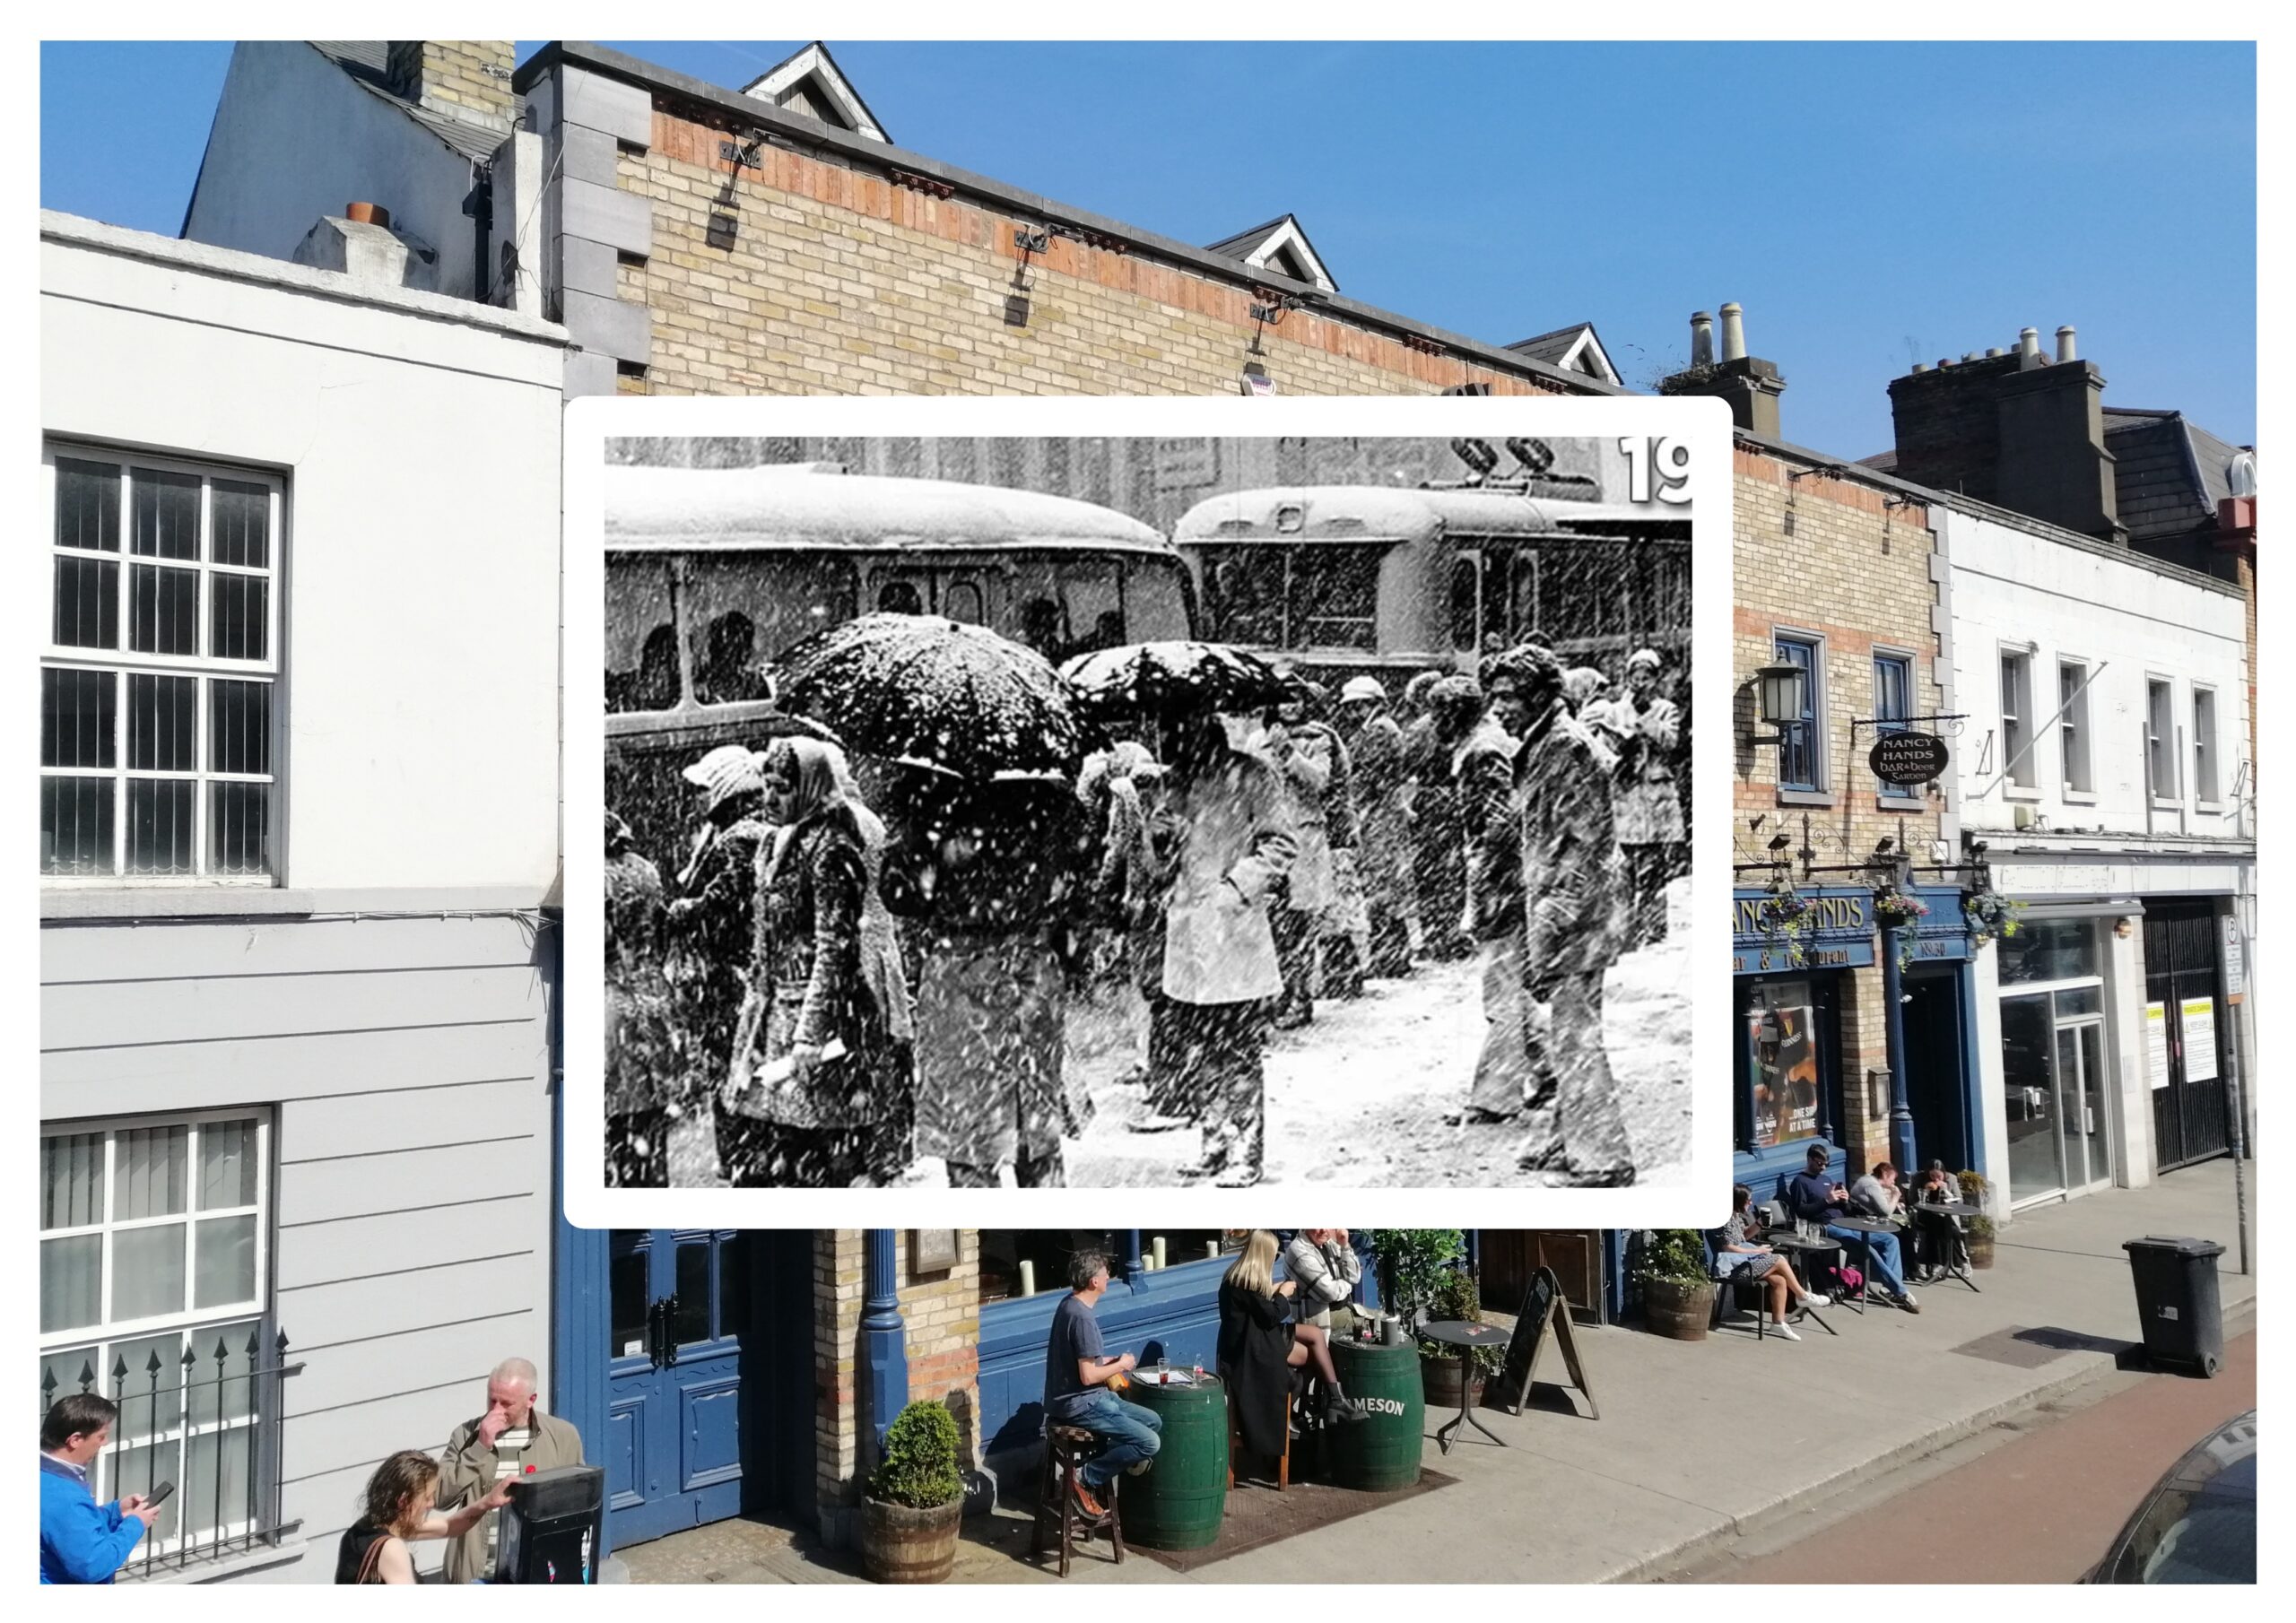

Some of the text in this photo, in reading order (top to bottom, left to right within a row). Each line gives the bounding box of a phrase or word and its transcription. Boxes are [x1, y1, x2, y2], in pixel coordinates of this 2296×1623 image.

[1883, 738, 1934, 749] NANCY
[1883, 751, 1935, 760] HANDS
[1761, 950, 1772, 970] &
[1802, 1117, 1816, 1130] TIME
[1349, 1398, 1405, 1416] MESON
